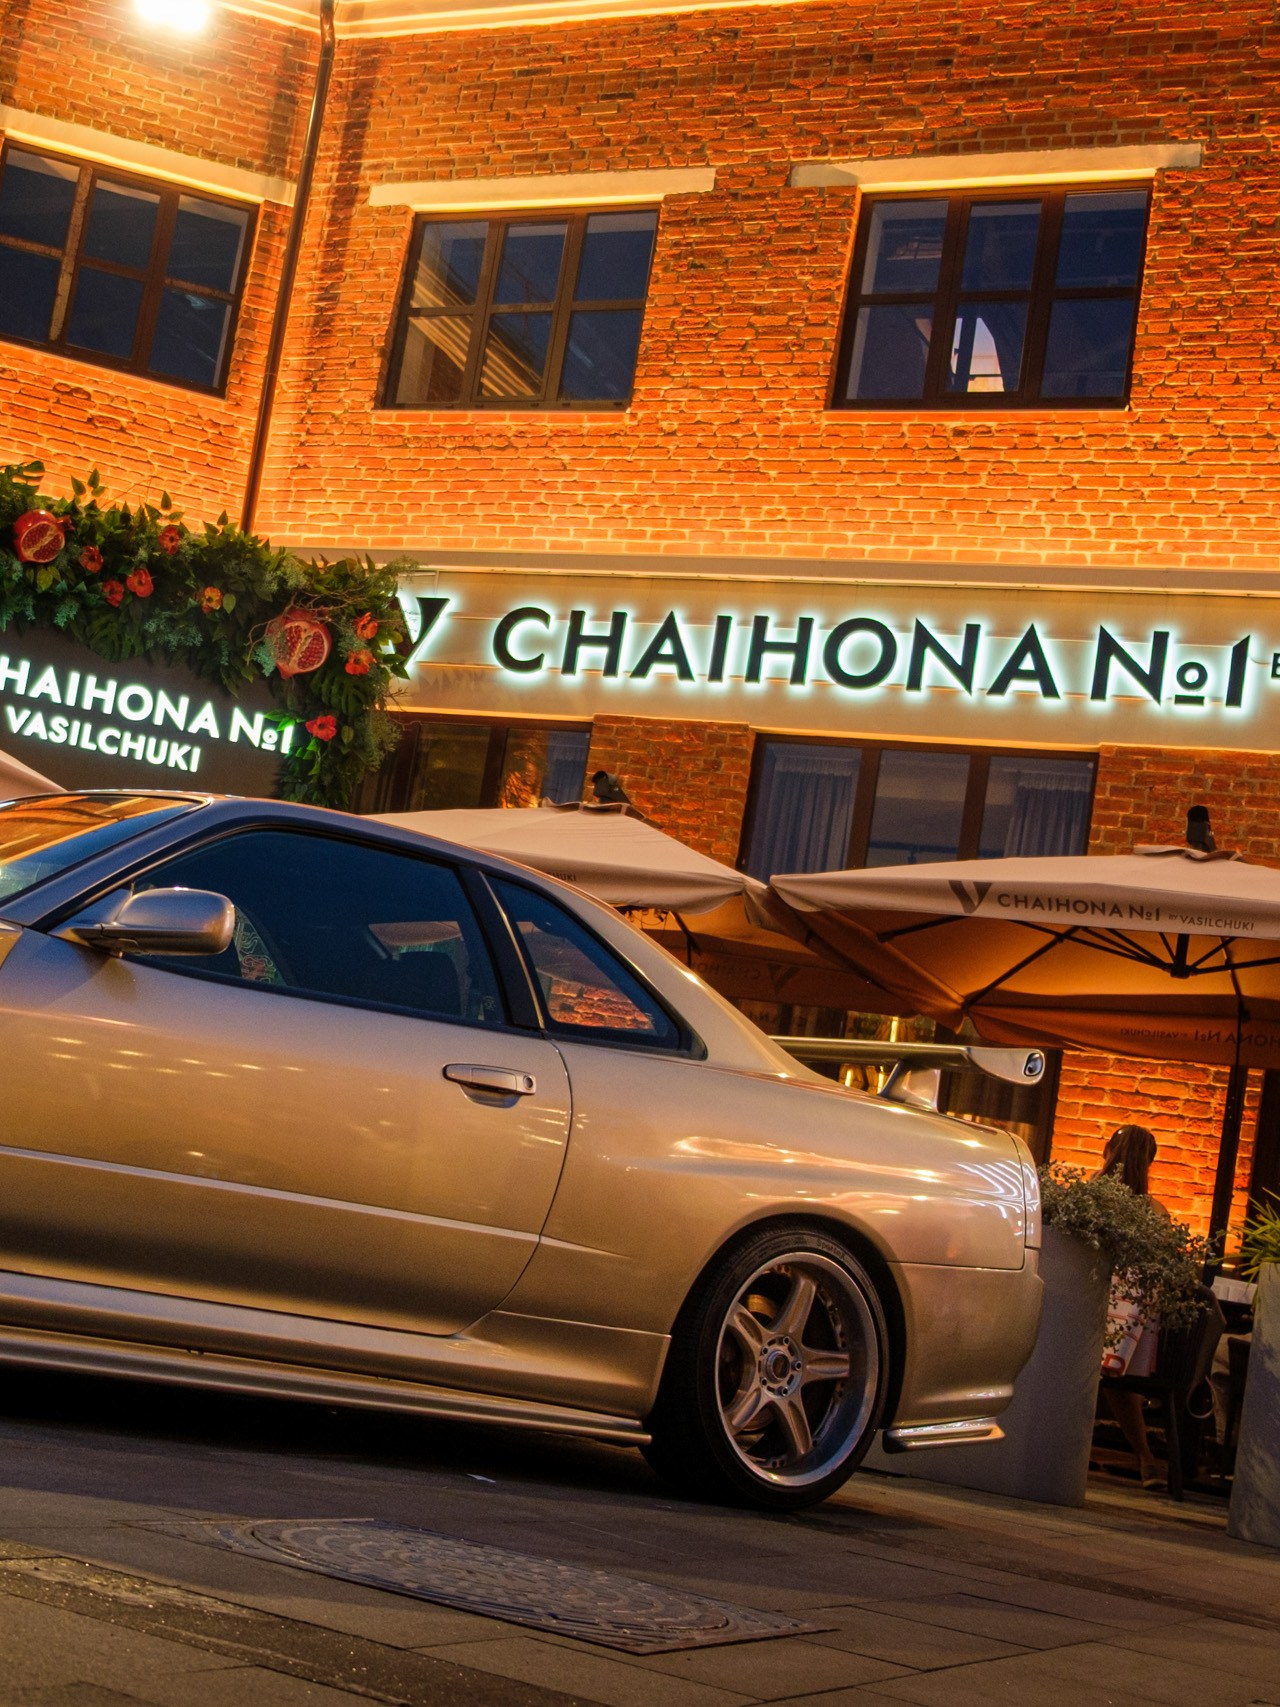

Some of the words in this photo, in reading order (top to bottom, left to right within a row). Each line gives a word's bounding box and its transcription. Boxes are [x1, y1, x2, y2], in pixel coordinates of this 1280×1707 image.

[493, 607, 1061, 700] CHAIHONA
[6, 710, 201, 773] VASILCHUKI
[997, 893, 1123, 919] CHAIHONA
[1178, 915, 1255, 931] VASILCHUKI
